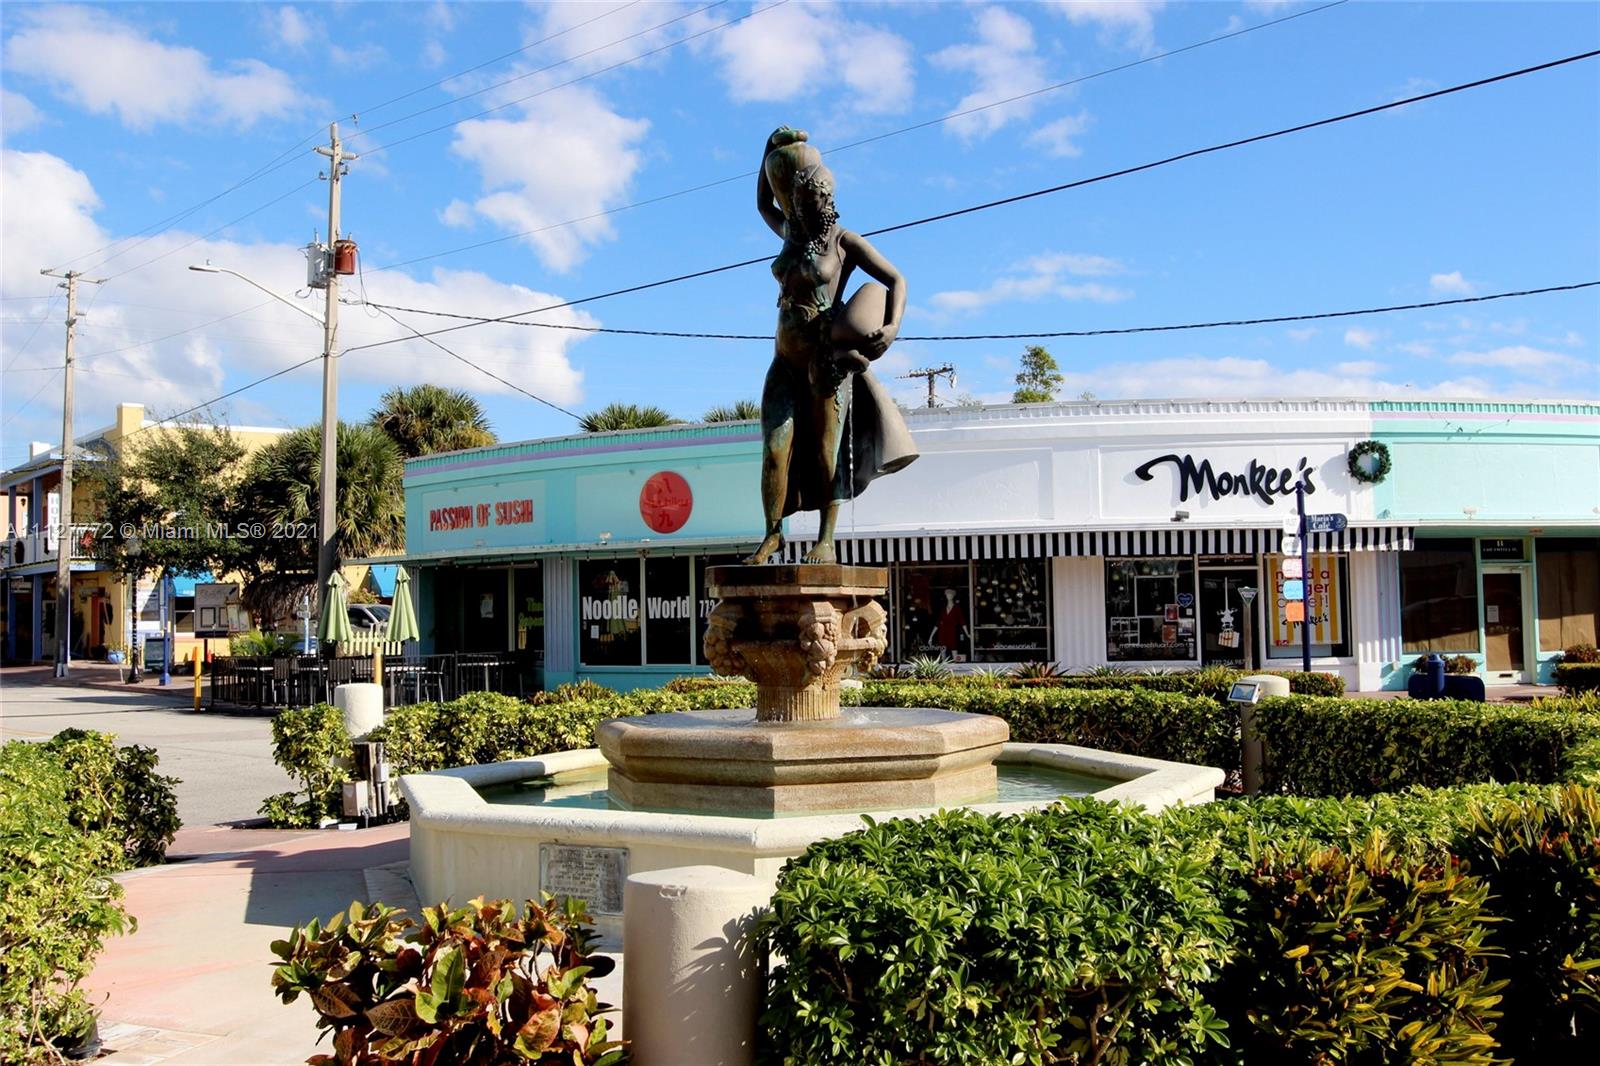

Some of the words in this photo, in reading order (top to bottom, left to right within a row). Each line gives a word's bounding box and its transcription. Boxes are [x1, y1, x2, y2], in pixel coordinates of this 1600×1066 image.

[1135, 454, 1316, 505] Monkee's
[429, 505, 473, 531] PASSION
[476, 503, 491, 527] OF
[495, 499, 533, 525] SUSHI
[1275, 568, 1315, 580] nd
[1320, 570, 1330, 579] a
[1276, 582, 1330, 596] bger
[582, 596, 639, 620] Noodle
[647, 596, 690, 620] World
